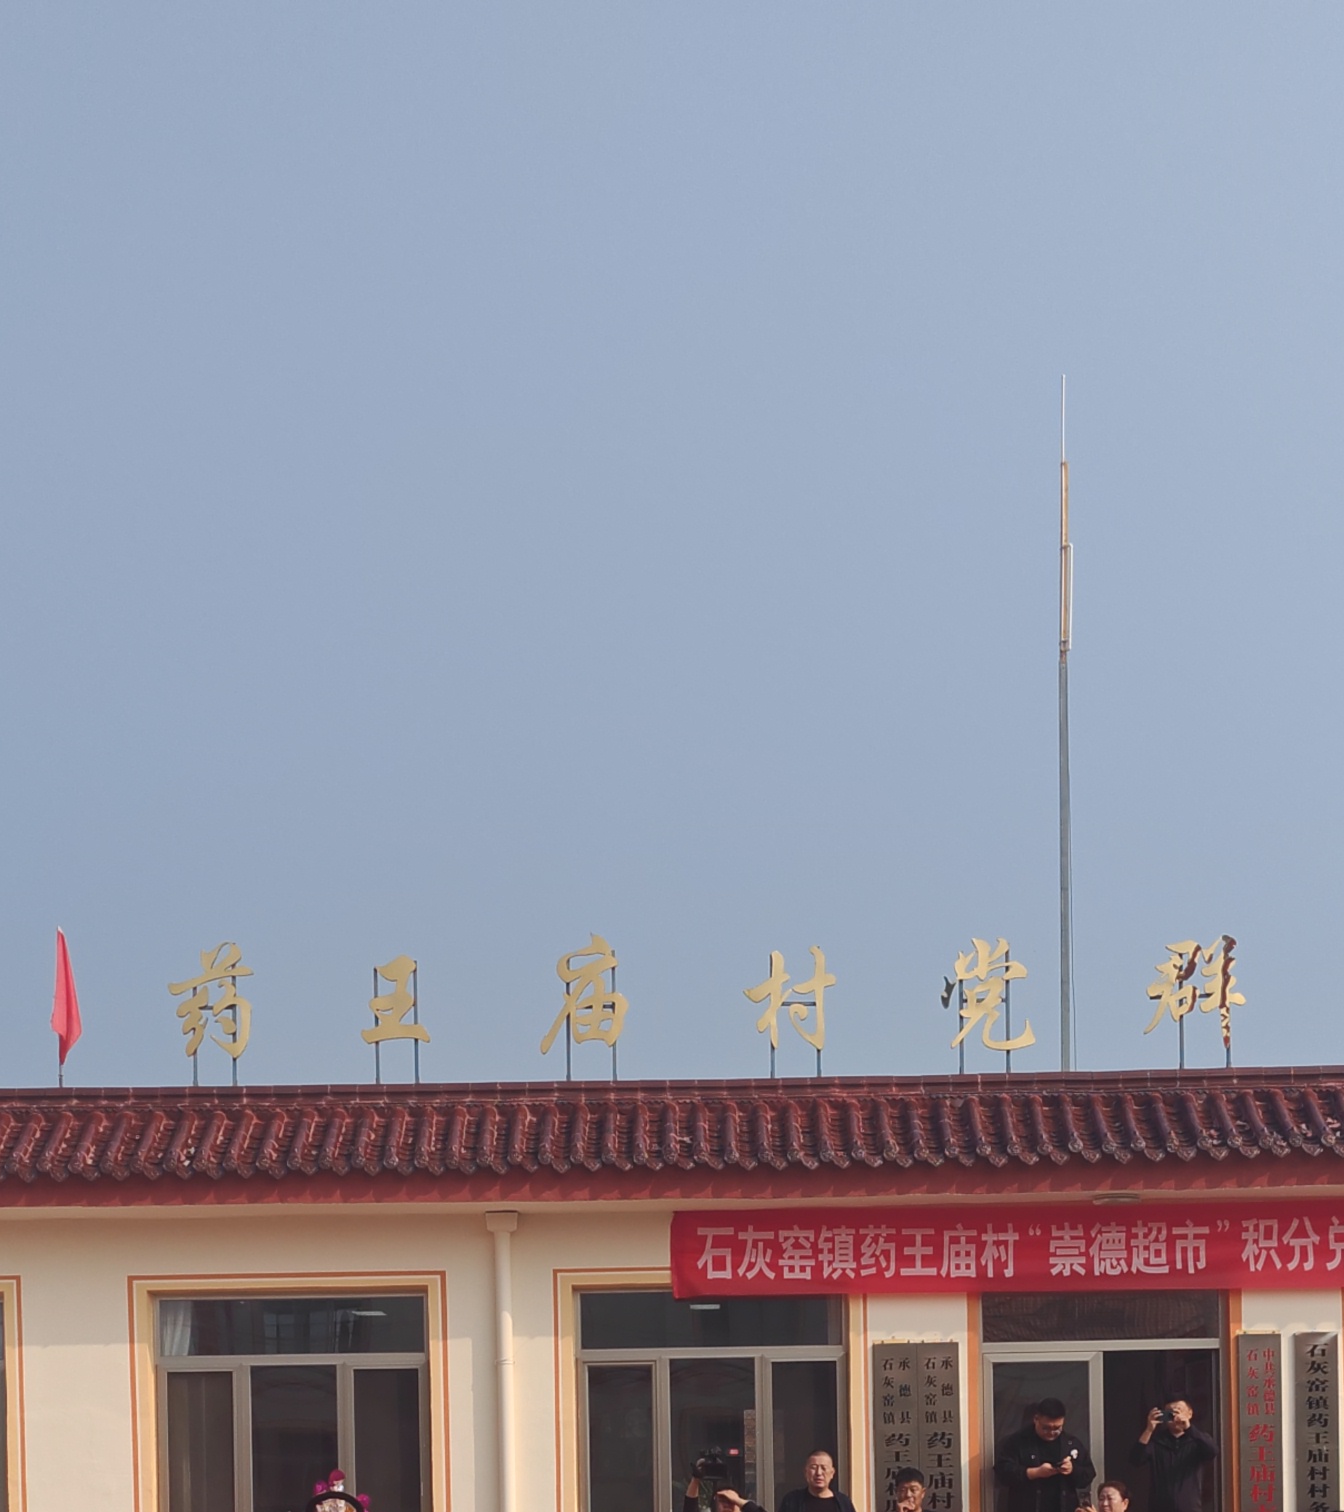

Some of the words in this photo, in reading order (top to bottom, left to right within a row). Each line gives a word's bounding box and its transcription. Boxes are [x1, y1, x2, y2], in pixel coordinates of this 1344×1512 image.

[882, 1358, 895, 1425] 石灰窑镇
[899, 1357, 911, 1424] 承德县
[924, 1357, 937, 1424] 石灰窑镇
[941, 1356, 954, 1423] 承德县
